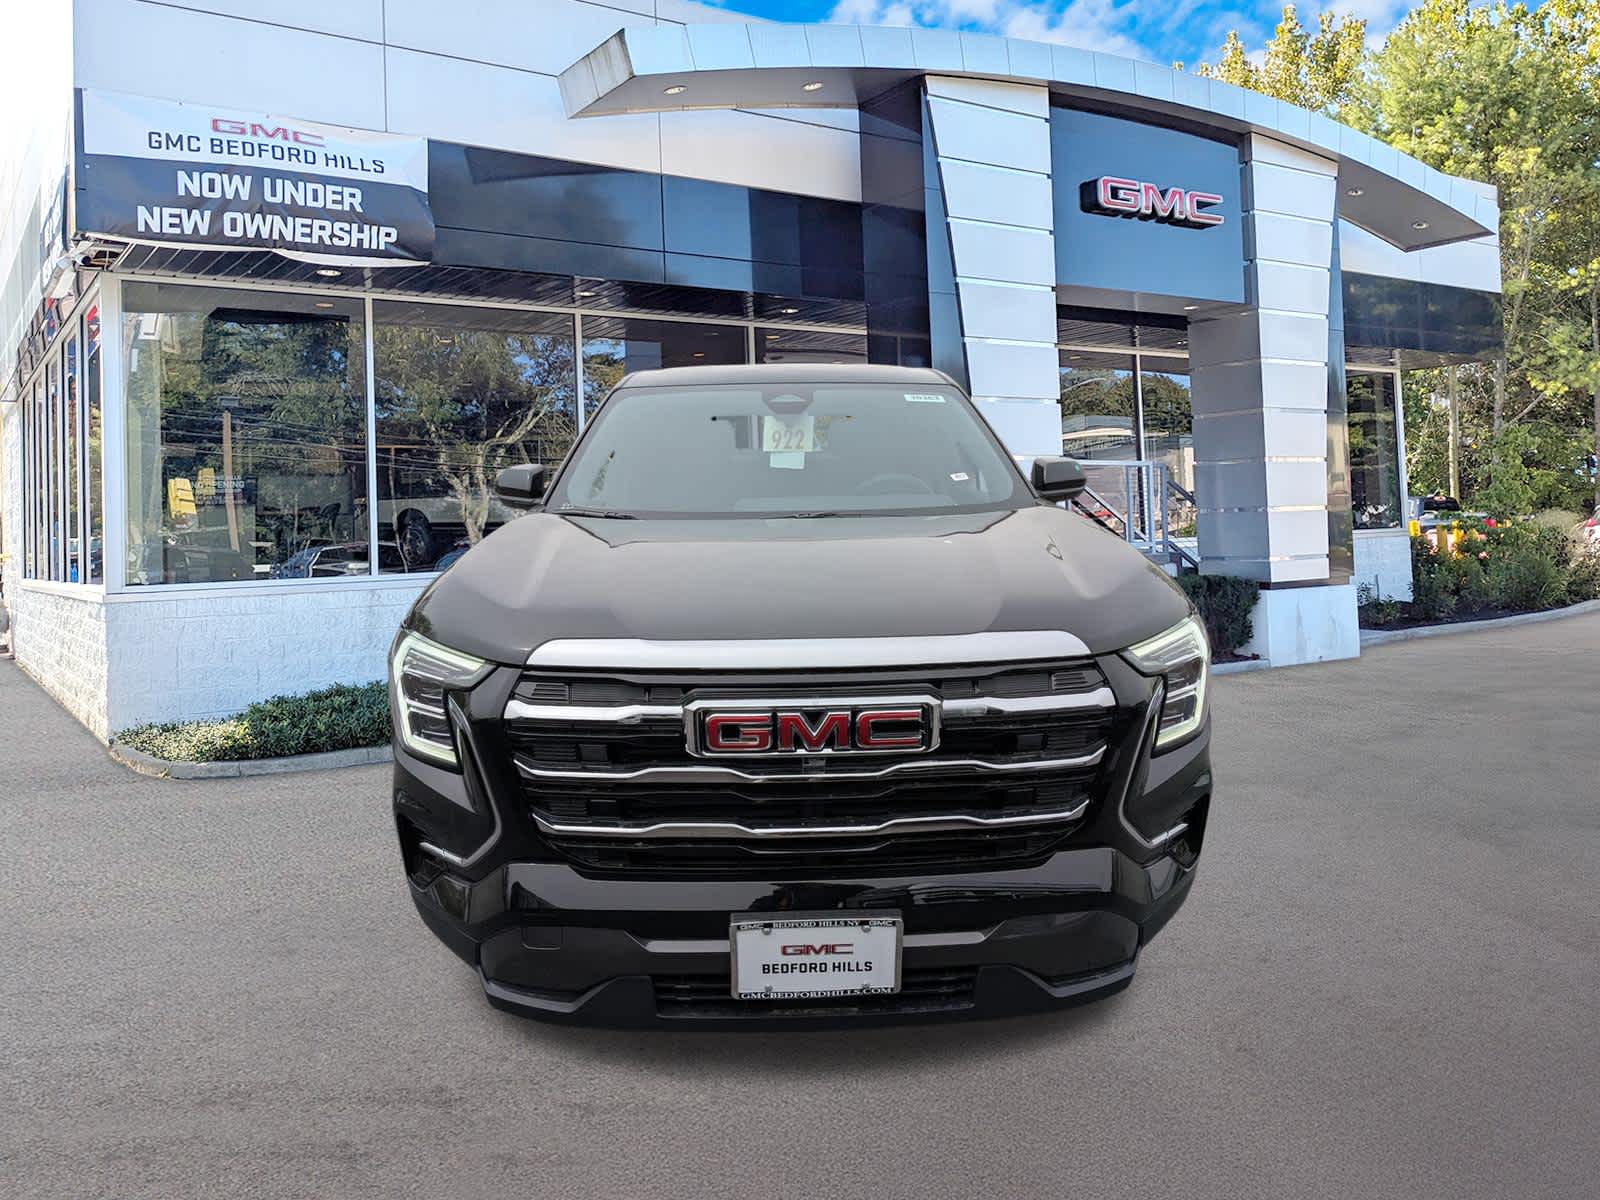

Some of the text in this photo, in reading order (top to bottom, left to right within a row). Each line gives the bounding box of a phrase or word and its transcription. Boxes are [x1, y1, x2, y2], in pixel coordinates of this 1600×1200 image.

[211, 118, 326, 148] GMC
[148, 131, 386, 174] GMC BEDFORD HILLS
[176, 170, 364, 213] NOW UNDER
[1096, 176, 1225, 225] GMC
[137, 205, 398, 250] NEW OWNERSHIP
[772, 431, 805, 450] 922
[706, 709, 923, 752] GMC
[772, 921, 817, 929] BEDFORD
[819, 920, 846, 928] HILLS
[868, 920, 893, 928] GMC
[781, 943, 854, 956] GMC
[762, 961, 873, 974] BEDFORD HILLS
[740, 987, 891, 1000] GMCBEDFORDHILLS.COM
